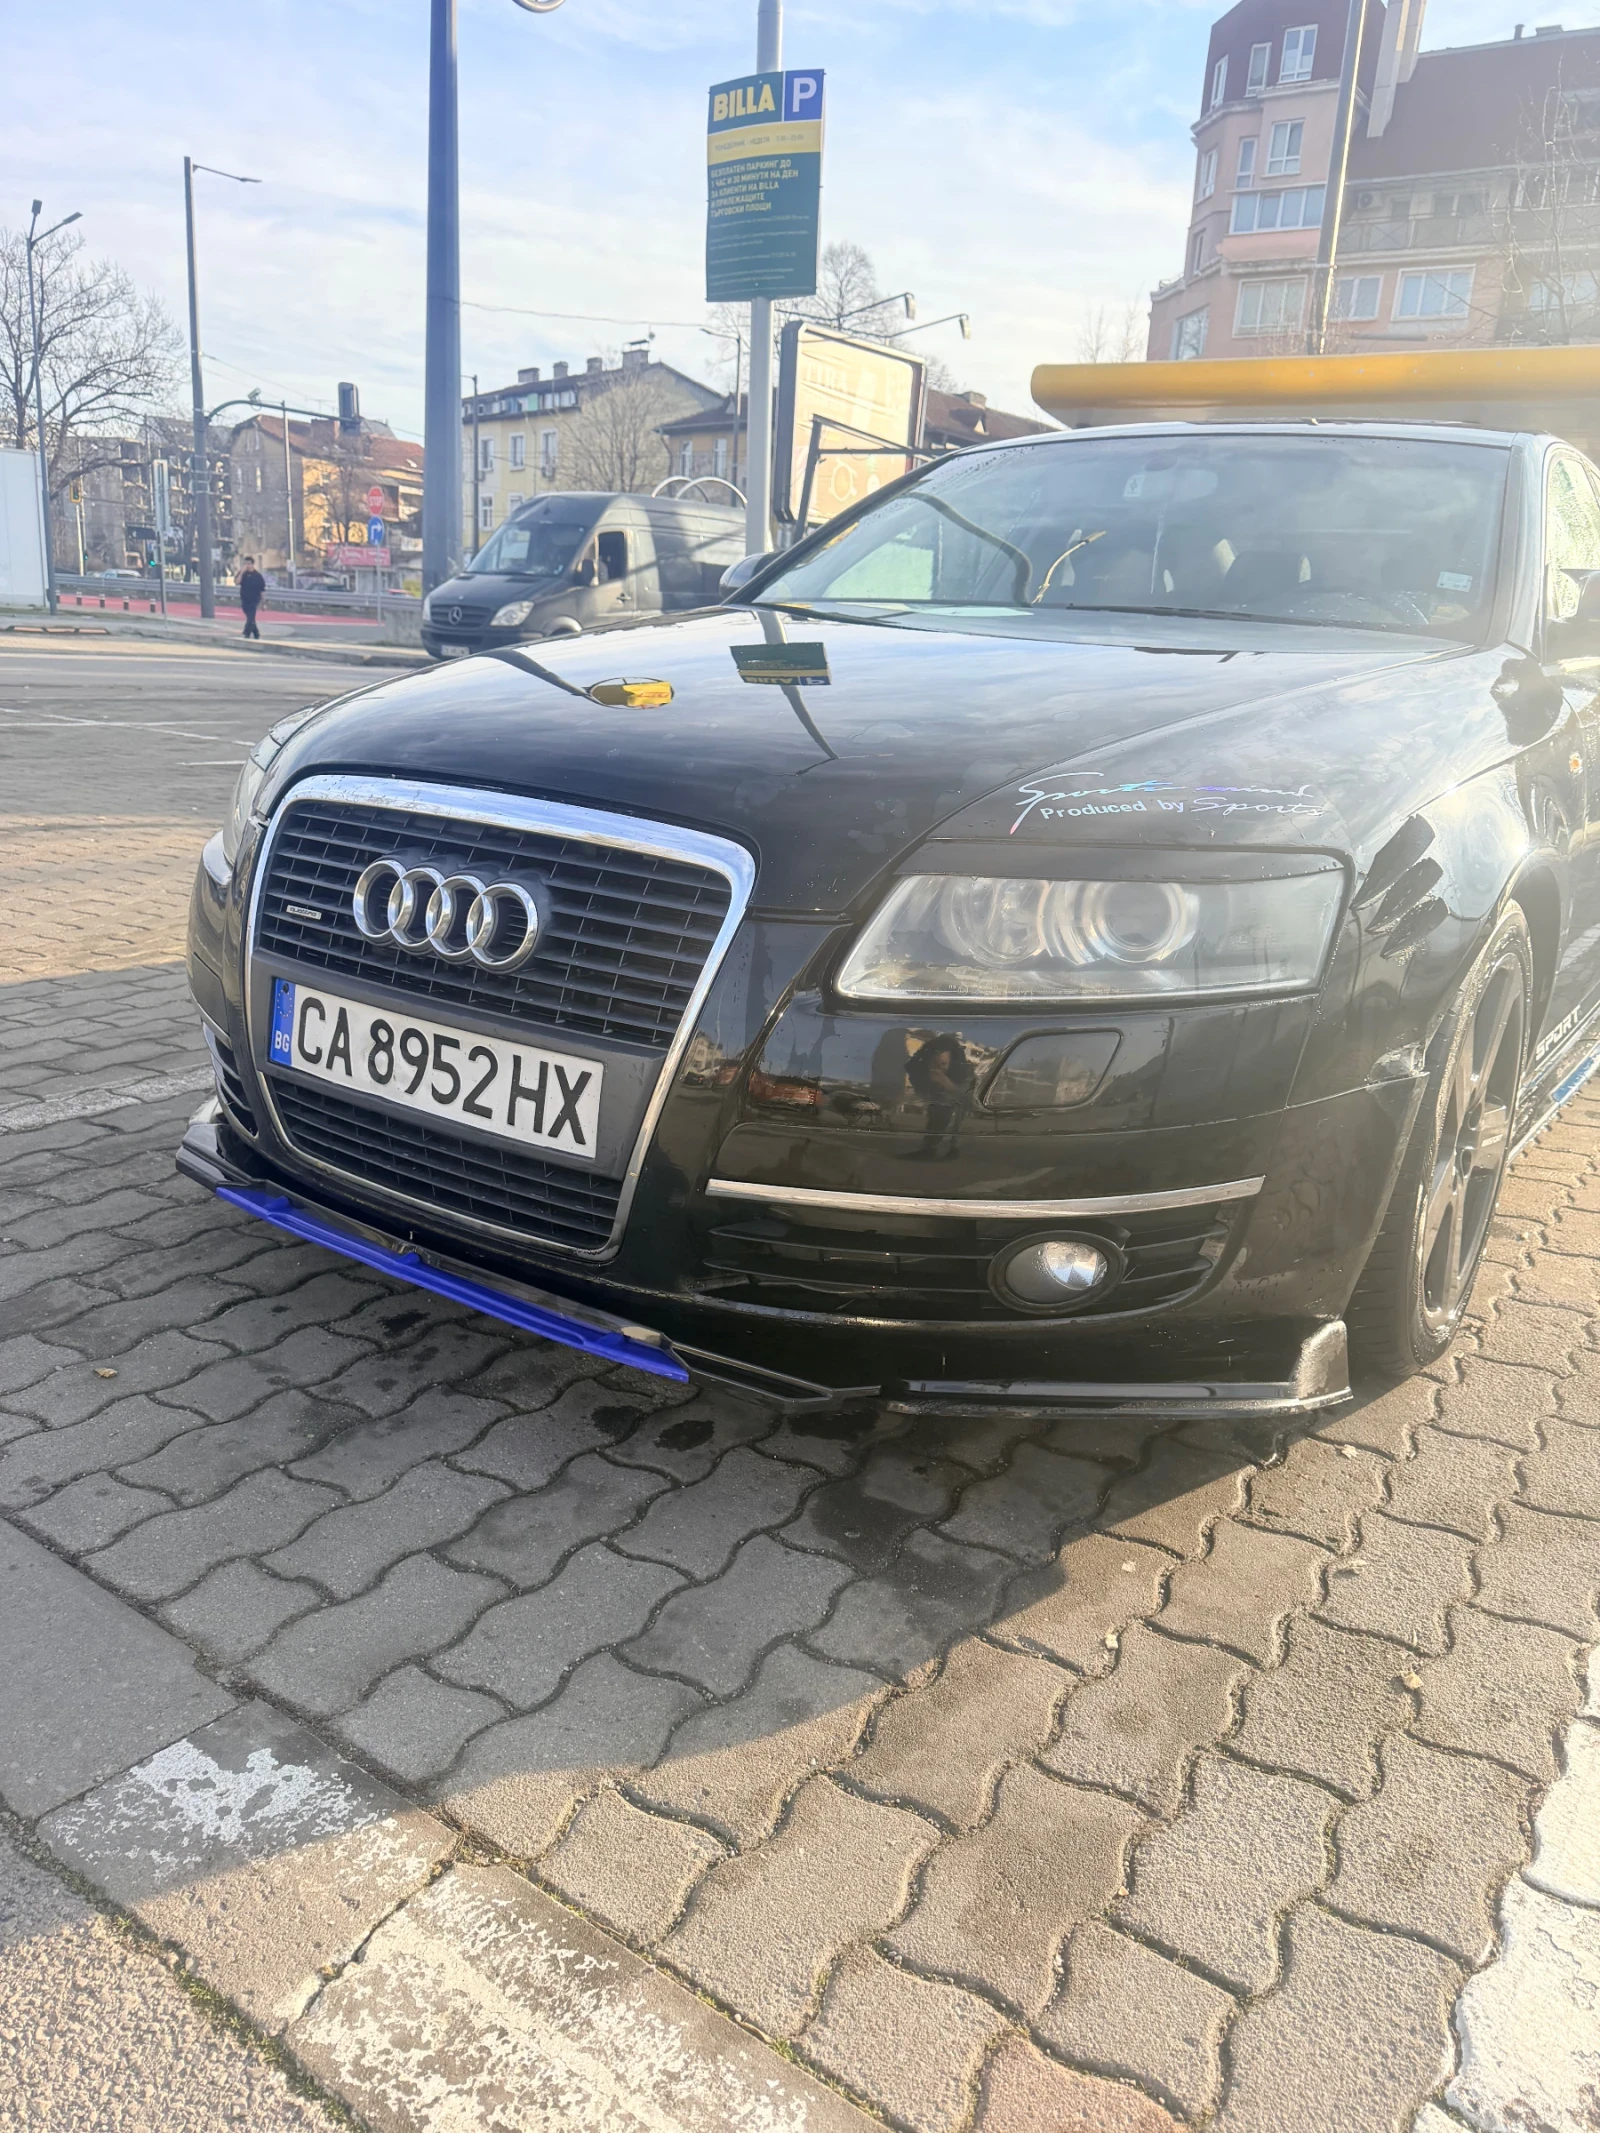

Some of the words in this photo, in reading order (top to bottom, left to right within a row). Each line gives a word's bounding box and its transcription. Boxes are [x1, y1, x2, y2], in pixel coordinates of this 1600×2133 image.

[713, 84, 776, 122] BILLA
[792, 77, 817, 113] P
[711, 164, 745, 178] БЕЗПЛАТЕН
[746, 160, 778, 172] ПАРКИНГ
[780, 159, 791, 169] ДО
[716, 178, 726, 187] ЧАС
[727, 176, 732, 185] И
[733, 176, 740, 184] 30
[741, 171, 769, 183] МИНУТИ
[770, 170, 781, 178] НА
[782, 169, 798, 180] ДЕН
[711, 190, 718, 198] ЗА
[720, 184, 747, 196] КЛИЕНТИ
[748, 183, 758, 192] НА
[759, 181, 779, 190] BILLA
[716, 192, 764, 208] ПРИЛЕЖАЩИТЕ
[711, 206, 744, 218] ТЪРГОВСКИ
[745, 202, 771, 212] ПЛОЩИ
[369, 496, 382, 506] STOP
[1040, 800, 1147, 820] Produced
[1157, 799, 1184, 813] by
[1190, 796, 1328, 816] Sports
[290, 907, 317, 917] quattro
[1536, 1004, 1581, 1061] SPORT
[274, 1030, 290, 1053] BG
[298, 996, 352, 1076] CA
[368, 1018, 498, 1120] 8952
[507, 1054, 592, 1145] HX
